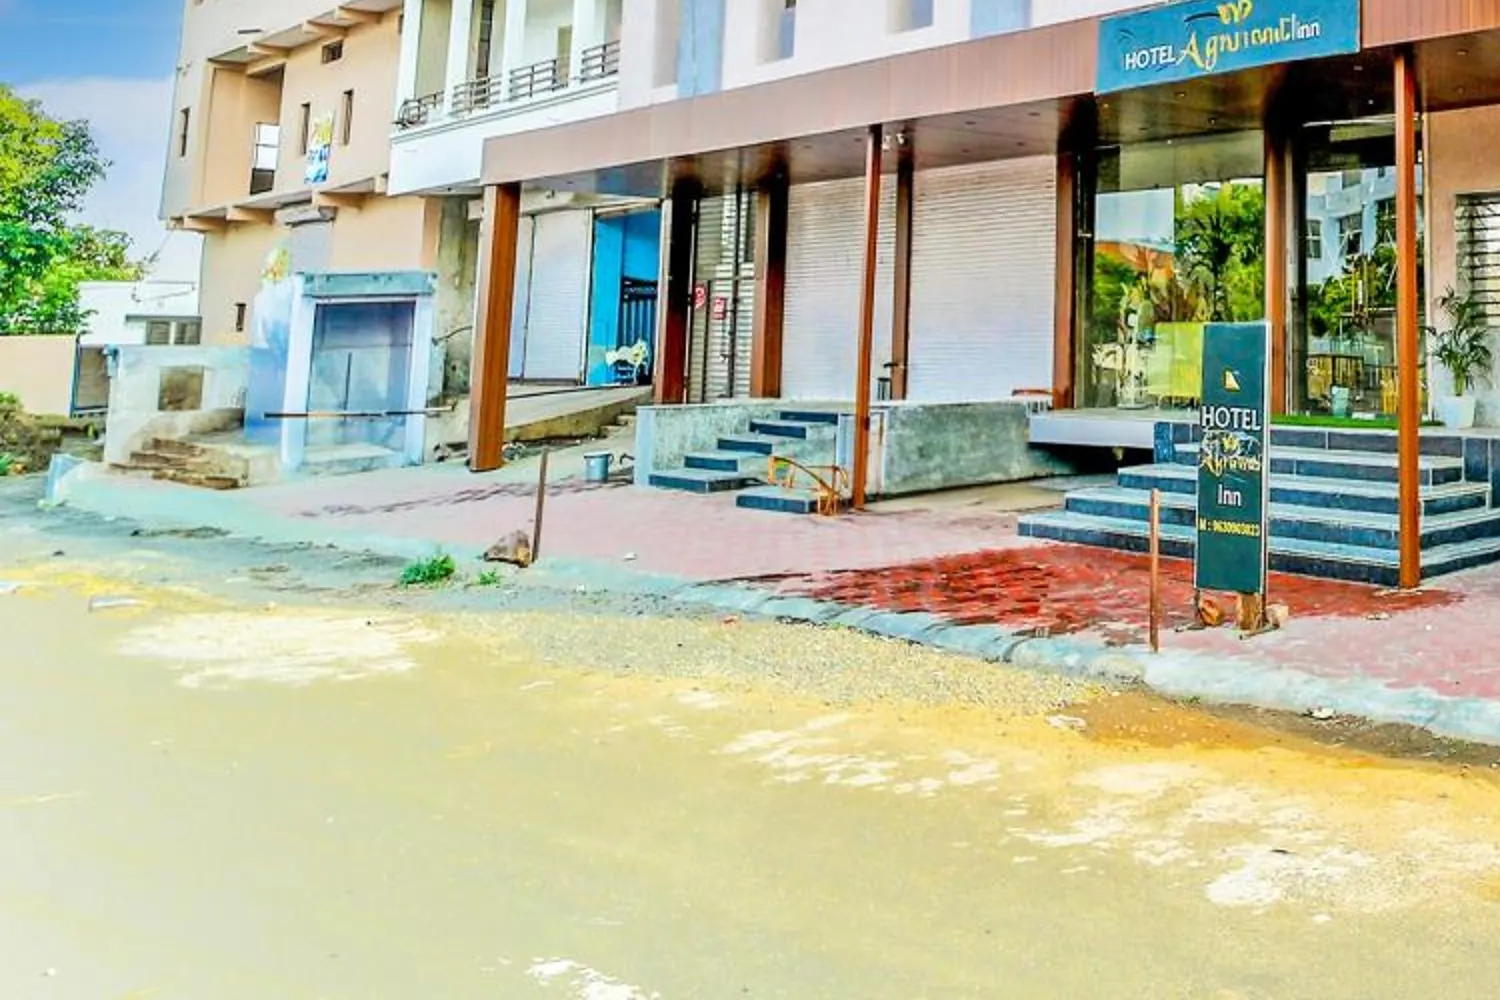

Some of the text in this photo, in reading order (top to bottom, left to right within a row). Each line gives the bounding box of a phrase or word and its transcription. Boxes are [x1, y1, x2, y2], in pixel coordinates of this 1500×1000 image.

[1125, 45, 1176, 70] HOTEL
[1201, 406, 1261, 430] HOTEL
[1217, 484, 1241, 506] Inn
